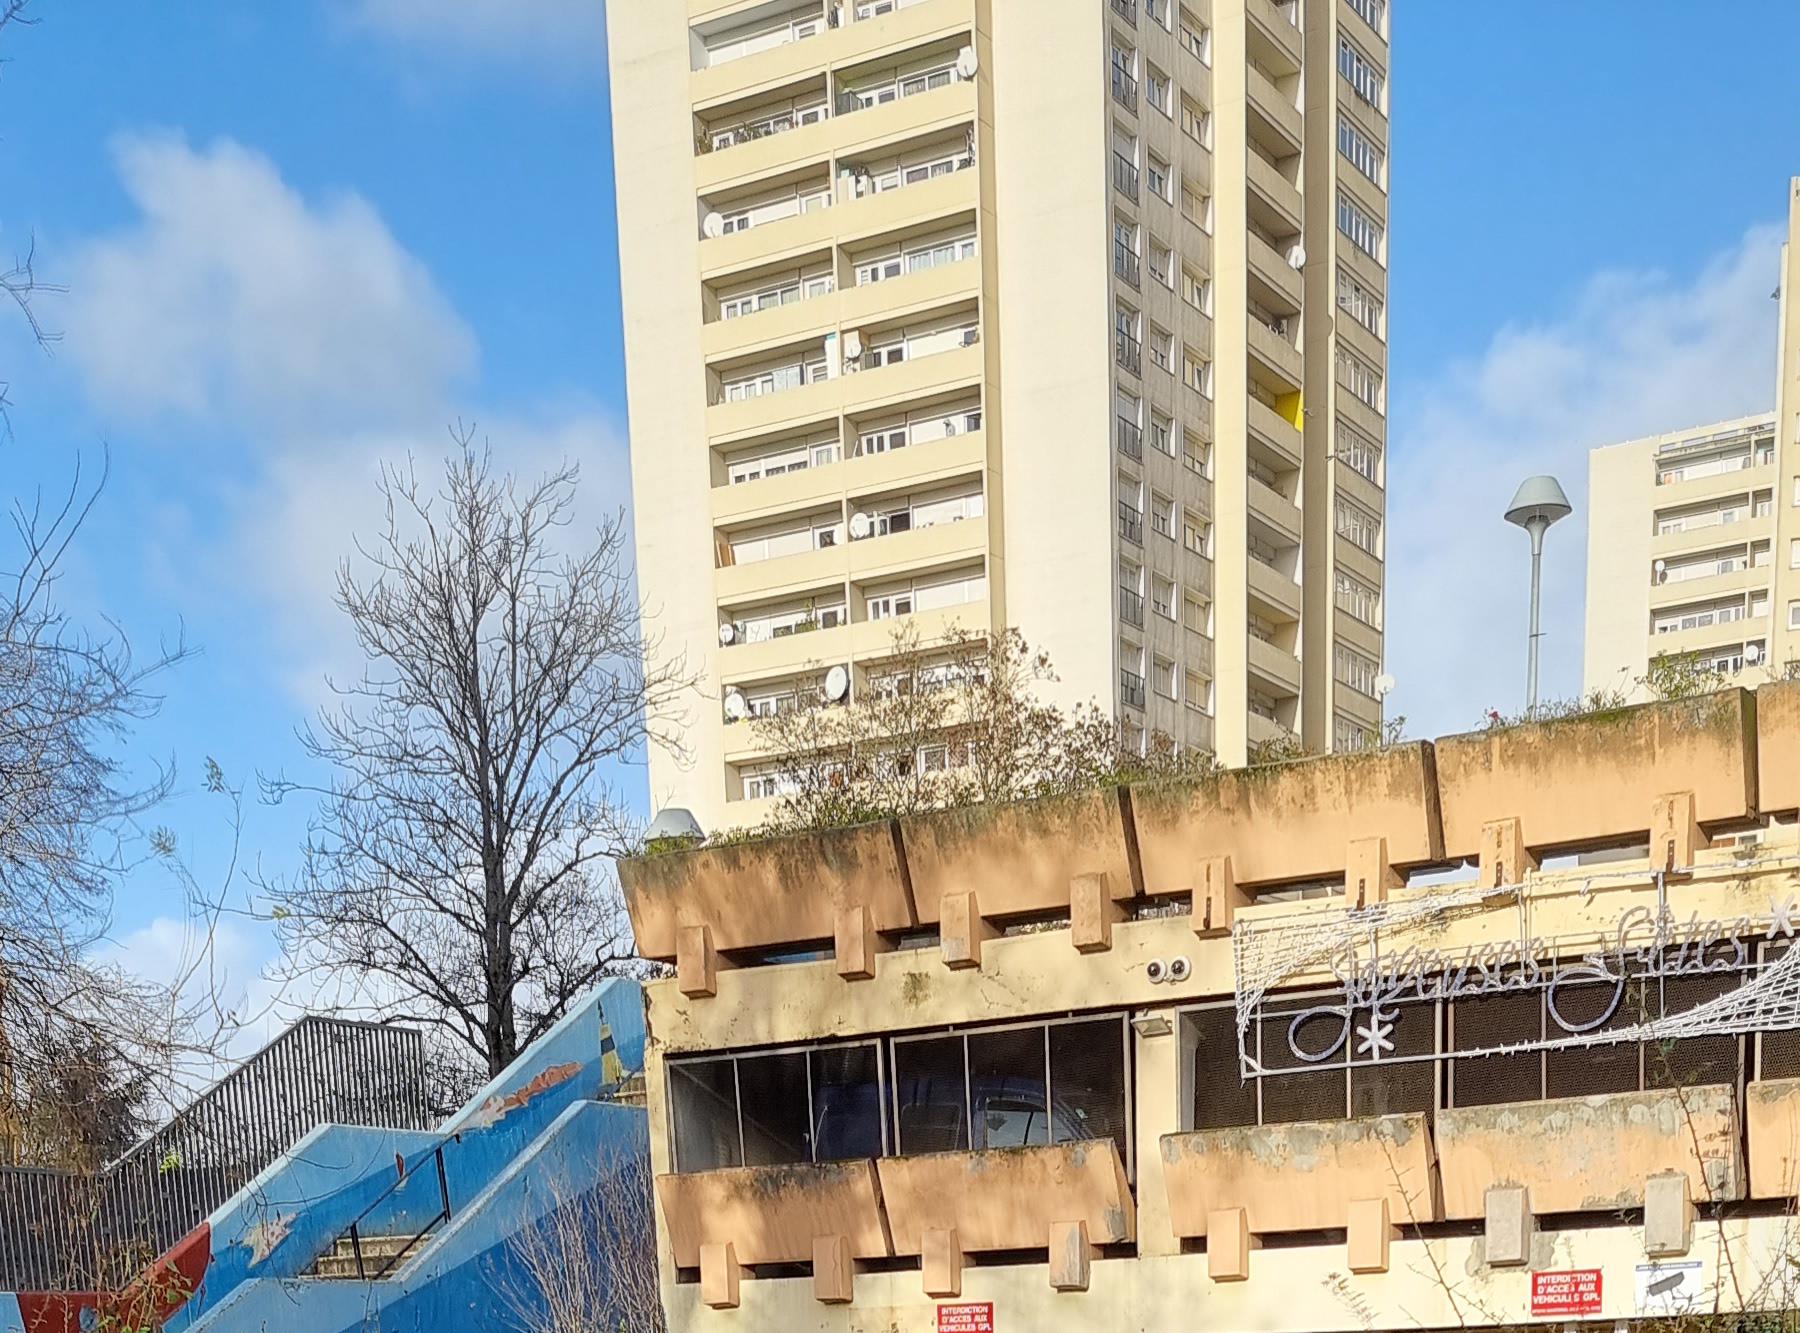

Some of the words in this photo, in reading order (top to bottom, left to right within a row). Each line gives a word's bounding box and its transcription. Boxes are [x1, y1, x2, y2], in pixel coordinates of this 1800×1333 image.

[1537, 1273, 1596, 1284] INTERDICTION
[1578, 1282, 1595, 1292] AUX
[1582, 1293, 1600, 1302] GPL
